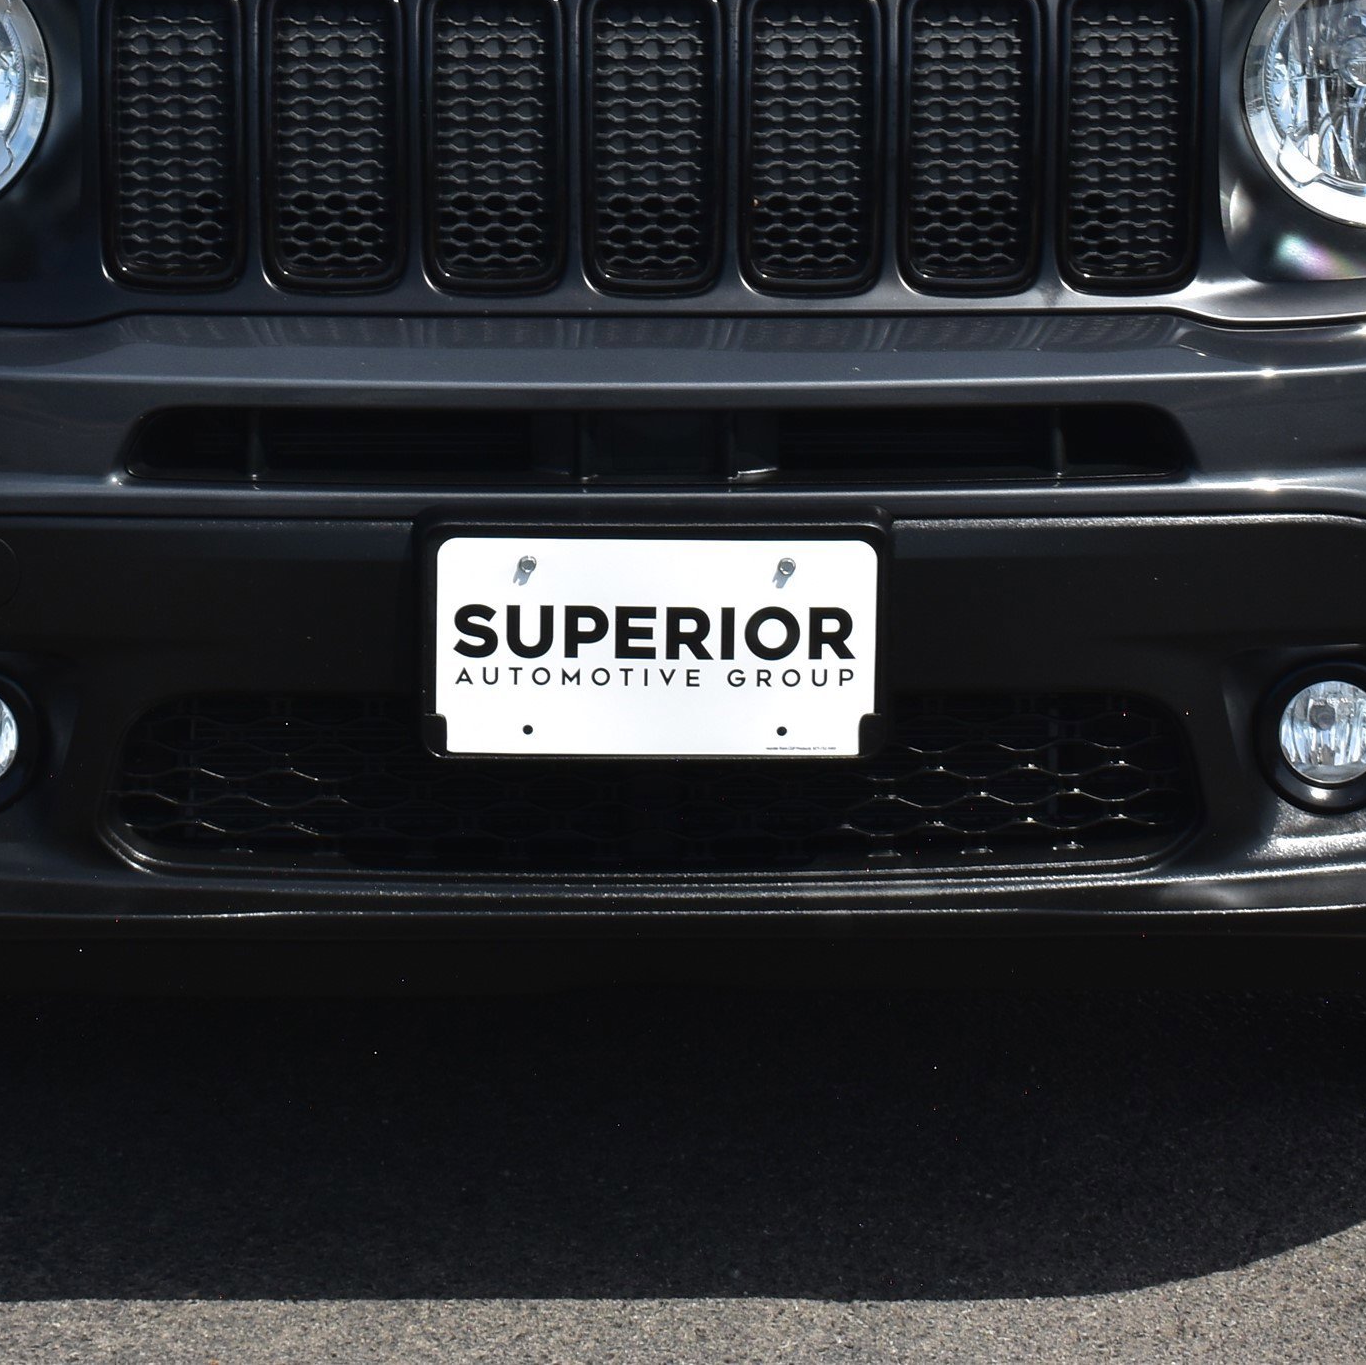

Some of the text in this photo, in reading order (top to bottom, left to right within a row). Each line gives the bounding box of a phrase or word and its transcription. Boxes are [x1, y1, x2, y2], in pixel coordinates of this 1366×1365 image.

[453, 603, 856, 661] SUPERIOR
[455, 666, 854, 688] AUTOMOTIVE GROUP
